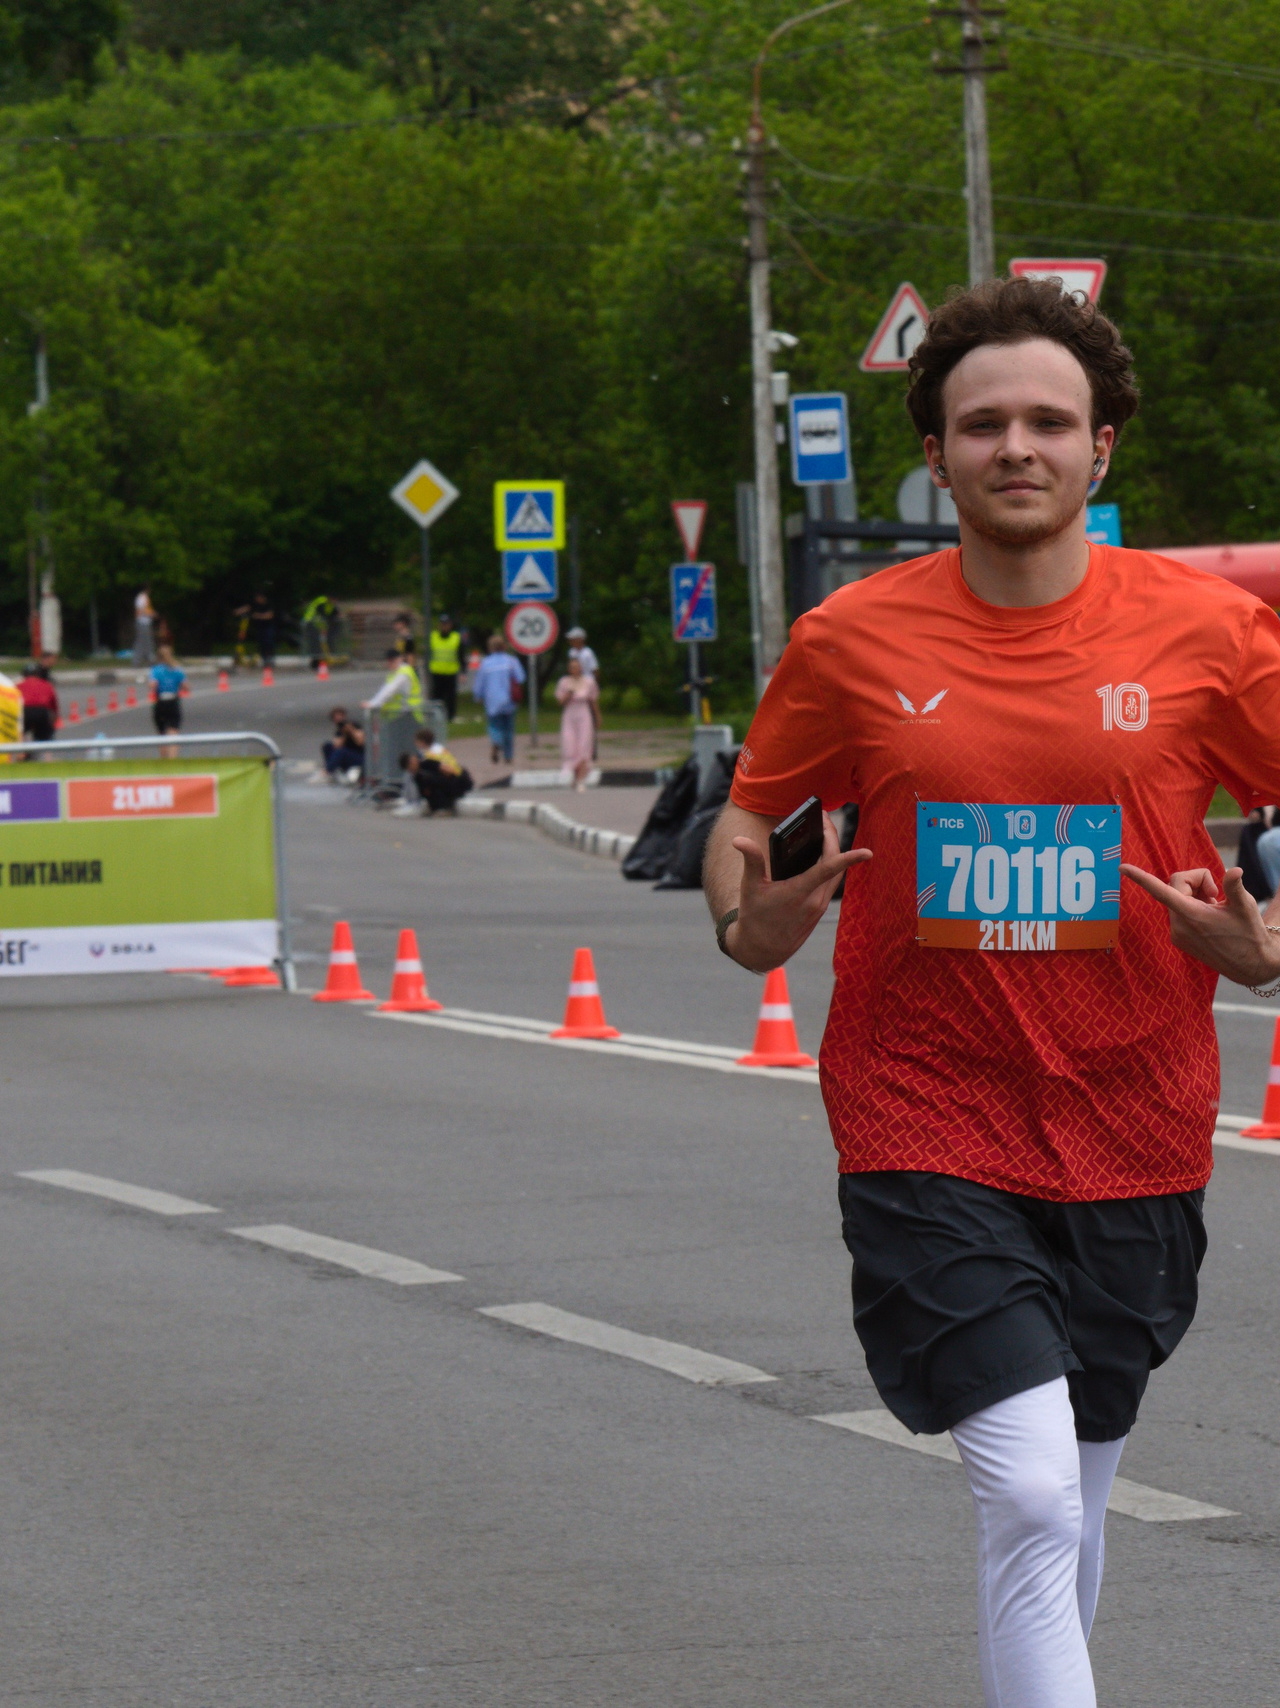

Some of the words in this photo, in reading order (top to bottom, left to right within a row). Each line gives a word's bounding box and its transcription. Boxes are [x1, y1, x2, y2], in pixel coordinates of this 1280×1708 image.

[518, 617, 544, 637] 20
[1095, 682, 1149, 731] 10
[940, 817, 965, 829] ПСБ
[1004, 809, 1037, 840] 10
[9, 860, 102, 887] ПИТАНИЯ
[941, 844, 1096, 917] 70116
